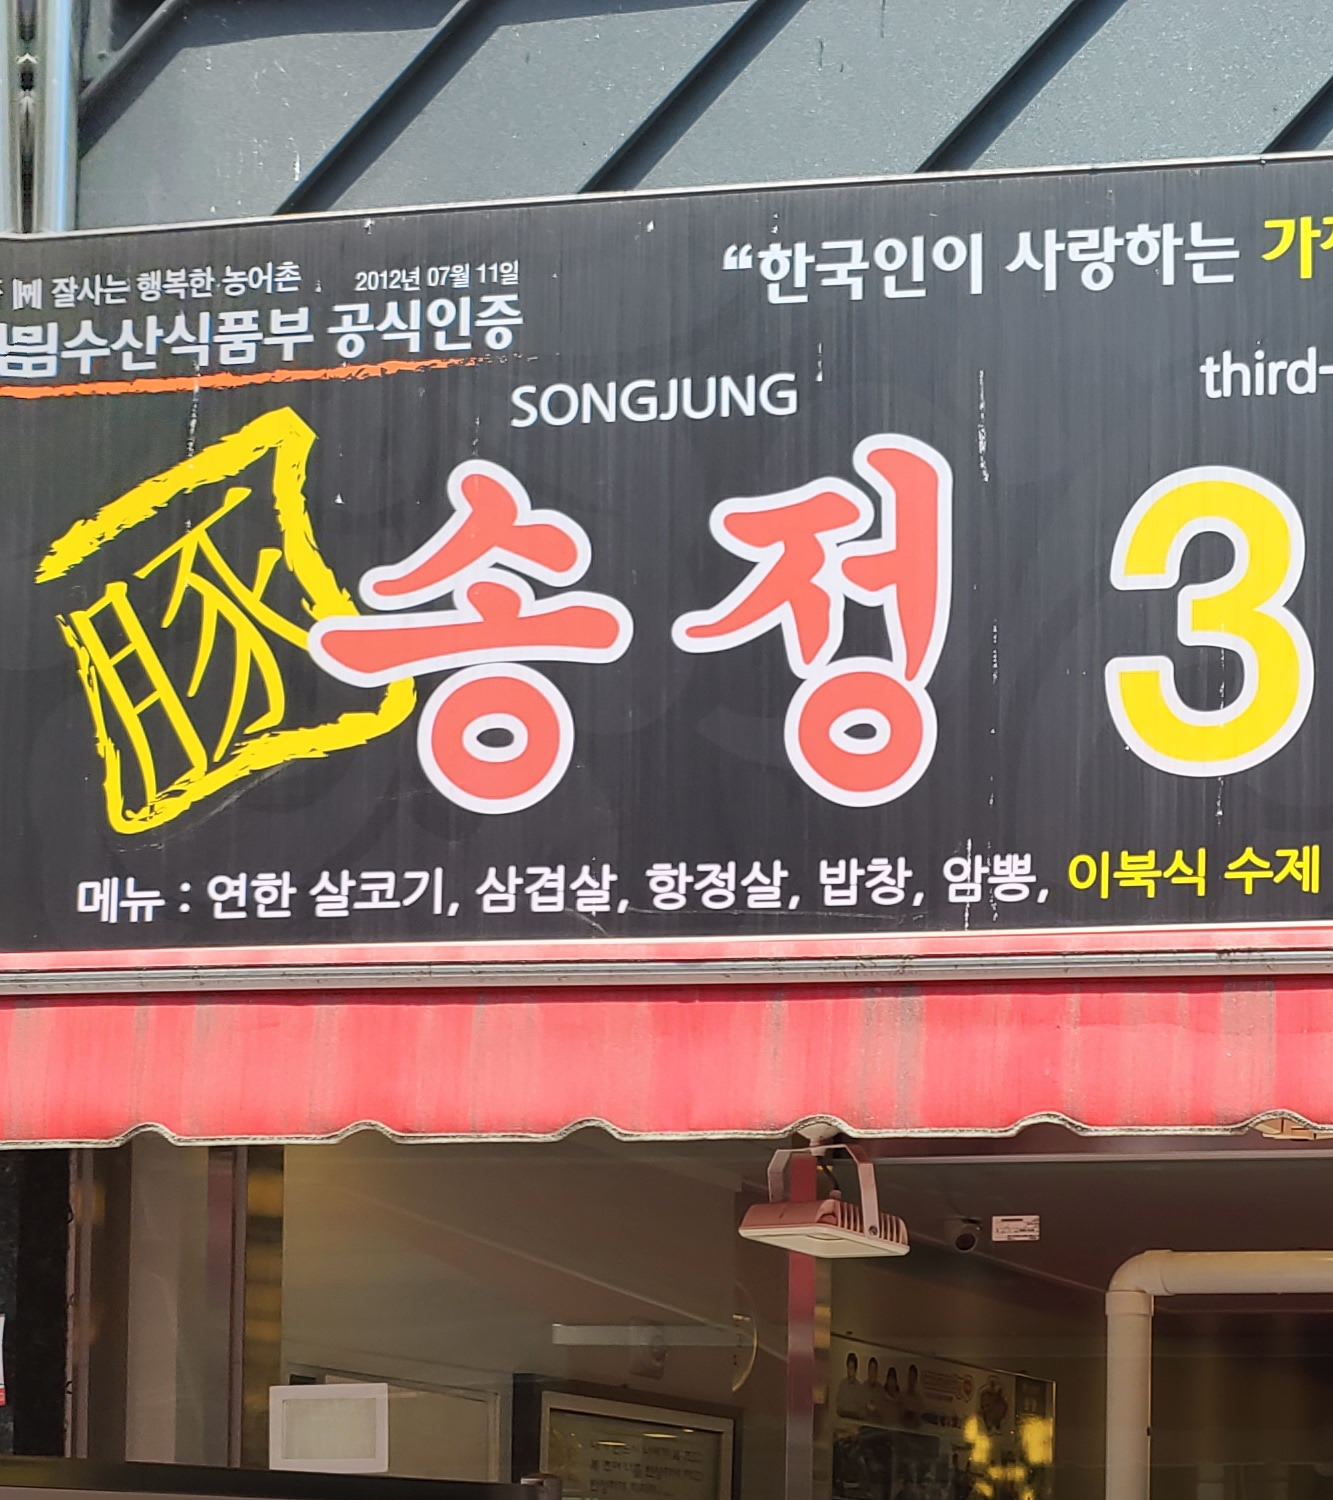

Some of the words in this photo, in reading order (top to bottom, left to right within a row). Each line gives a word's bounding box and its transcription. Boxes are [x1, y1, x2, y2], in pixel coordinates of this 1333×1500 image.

[50, 276, 132, 309] 잘사는
[135, 270, 217, 303] 행복한
[217, 262, 303, 298] 농어촌
[354, 265, 422, 292] 2012년
[426, 263, 471, 289] 07월
[475, 259, 521, 287] 11일
[1005, 221, 1241, 292] 사랑하는
[326, 292, 525, 360] 공식인증
[511, 372, 800, 431] SONGJUNG
[307, 431, 955, 816] 송정
[76, 874, 168, 924] 메뉴
[205, 869, 297, 921] 연한
[308, 867, 461, 919] 살코기,
[475, 863, 629, 917] 삼겹살,
[644, 857, 800, 912] 항정살,
[1066, 845, 1206, 900] 이북식
[1223, 843, 1321, 896] 수제
